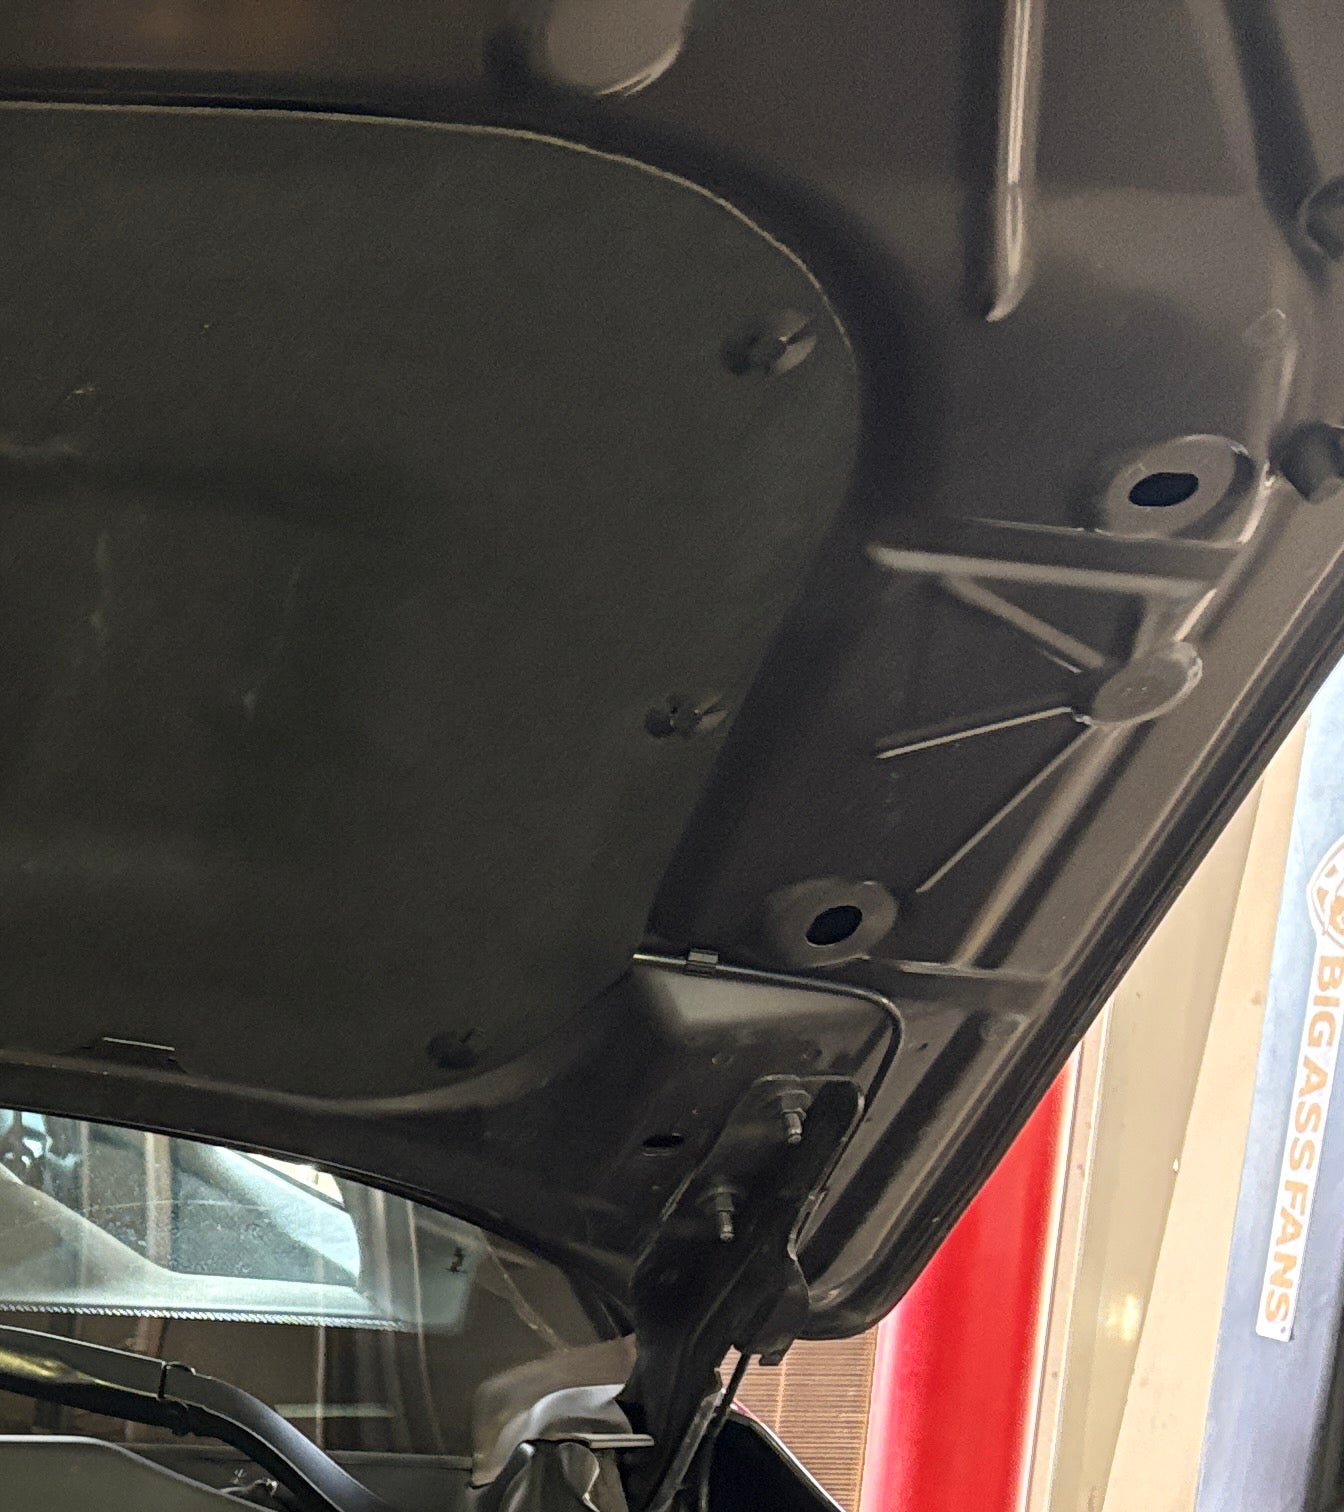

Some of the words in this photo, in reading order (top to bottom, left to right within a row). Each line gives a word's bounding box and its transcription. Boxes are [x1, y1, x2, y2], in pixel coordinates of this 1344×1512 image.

[1308, 956, 1344, 1047] BIG
[1289, 1056, 1328, 1170] ASS
[1265, 1180, 1308, 1322] FANS
